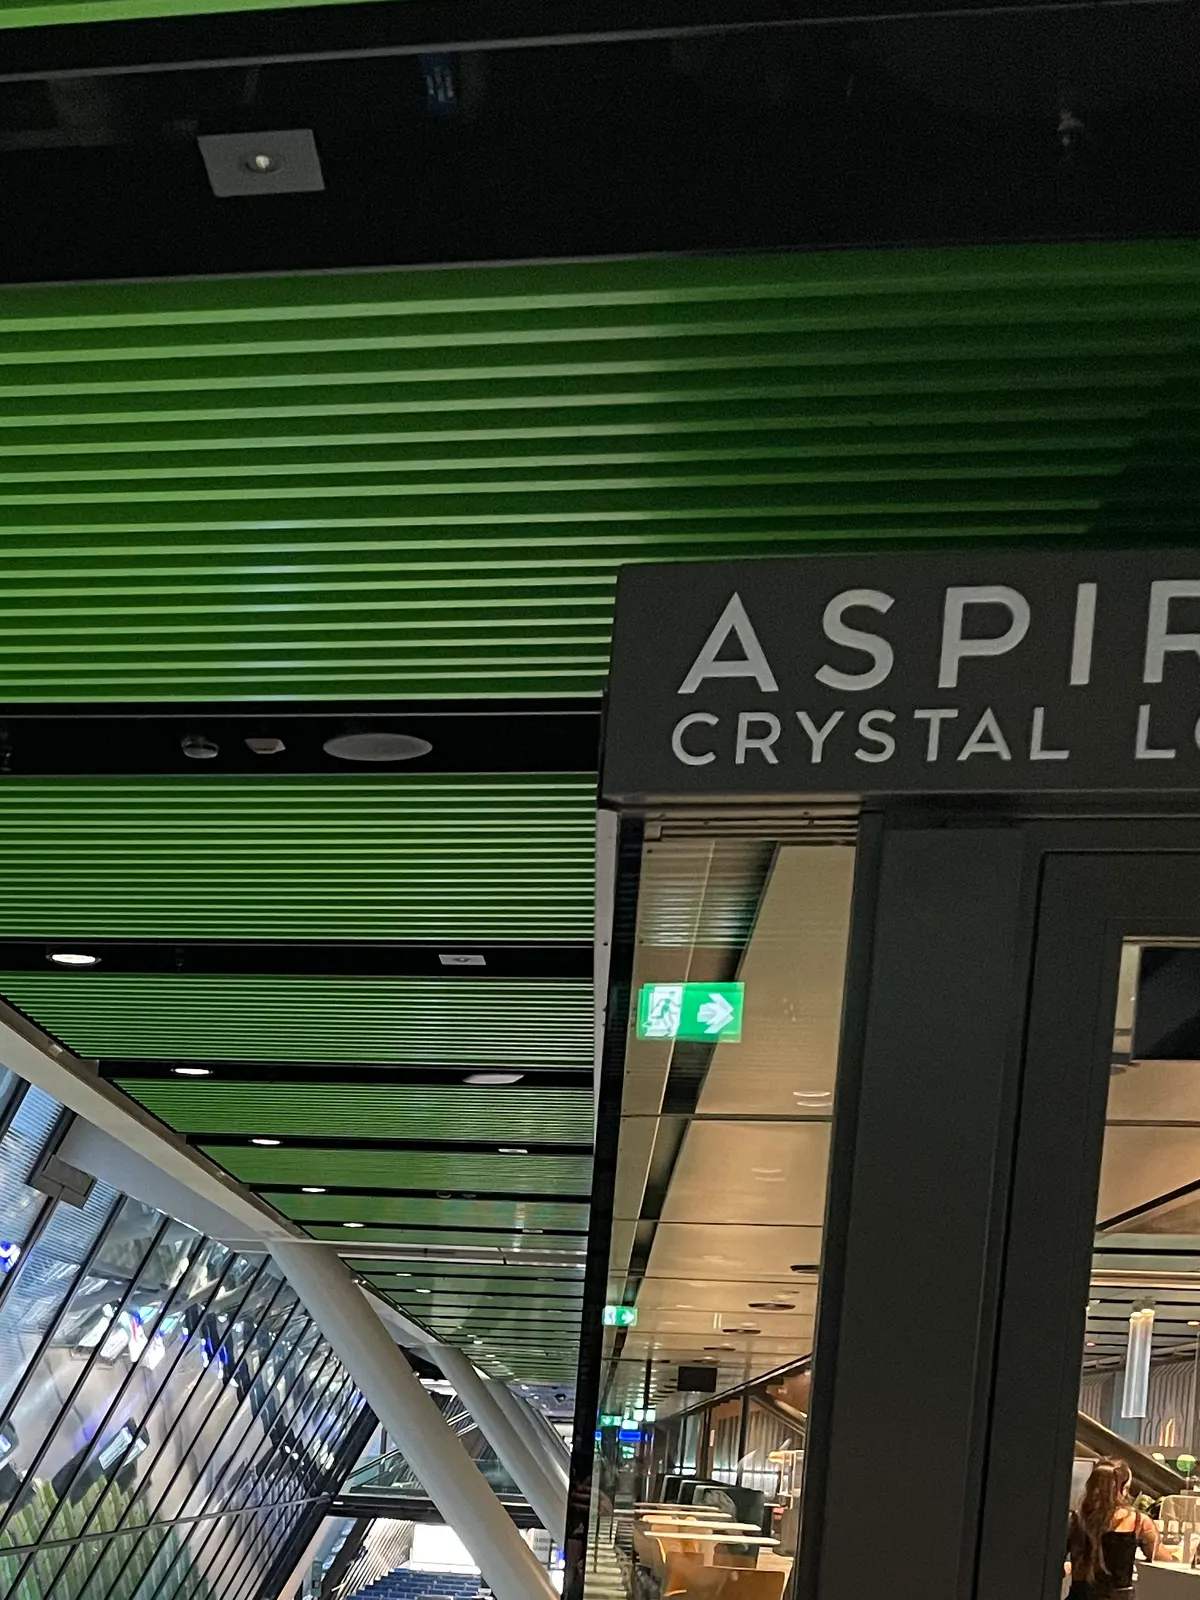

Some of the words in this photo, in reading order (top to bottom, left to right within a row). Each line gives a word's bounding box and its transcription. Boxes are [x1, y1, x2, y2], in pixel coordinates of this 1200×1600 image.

[677, 580, 1200, 694] ASPIR
[671, 706, 1070, 766] CRYSTAL
[1134, 704, 1200, 760] L
